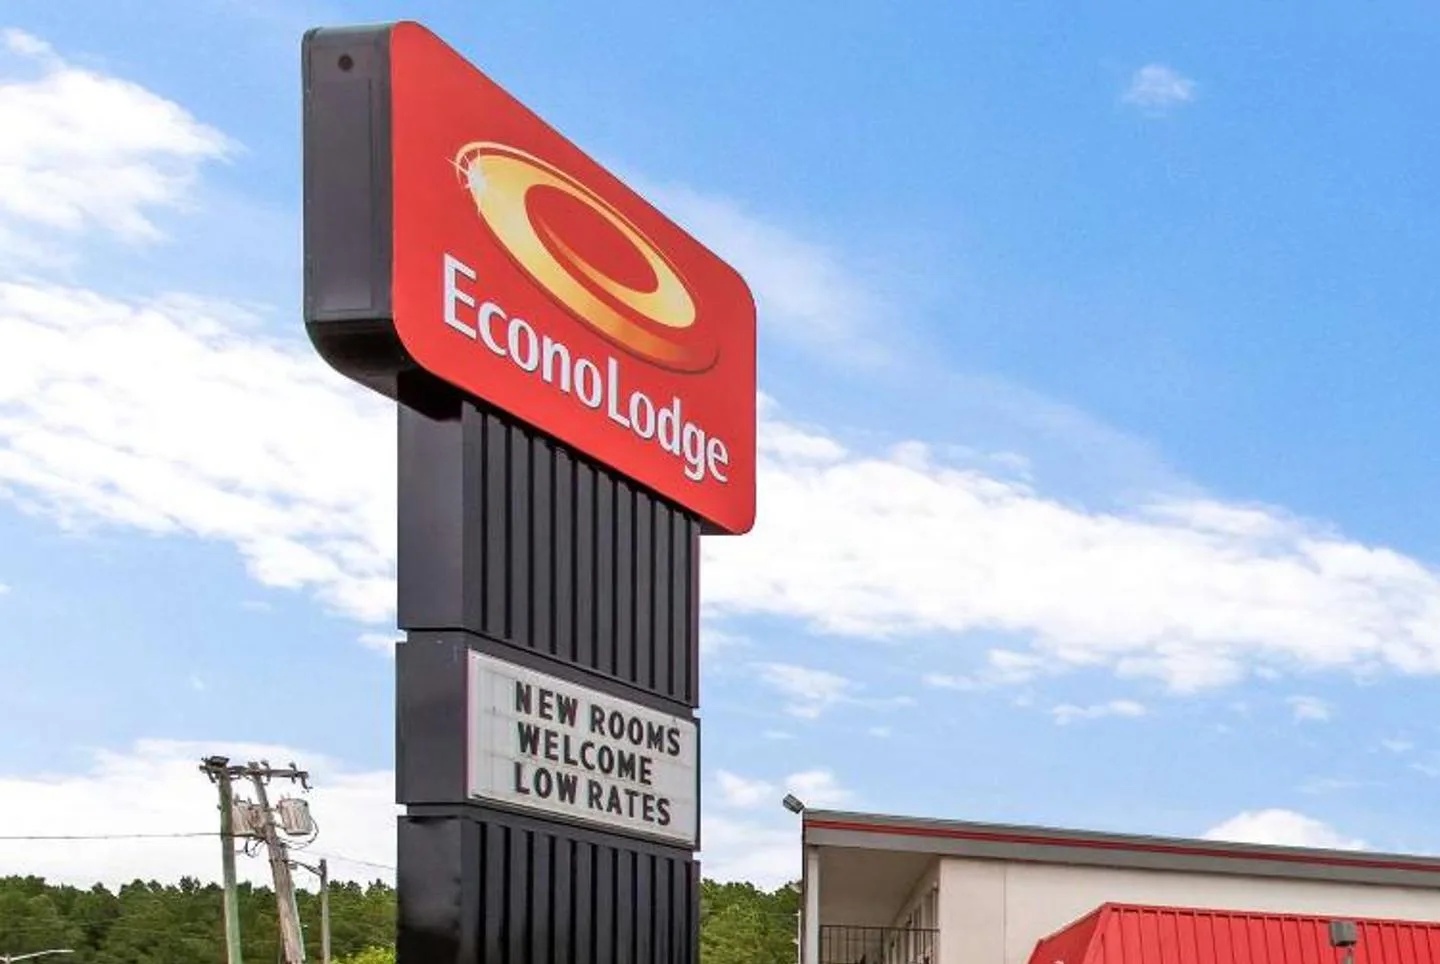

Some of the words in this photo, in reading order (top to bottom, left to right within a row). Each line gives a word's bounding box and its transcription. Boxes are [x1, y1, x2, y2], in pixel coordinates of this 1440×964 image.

[442, 252, 730, 484] EconoLodge
[515, 680, 579, 728] NEW
[590, 703, 681, 756] ROOMS
[518, 721, 653, 786] WELCOME
[514, 762, 579, 805] LOW
[588, 779, 672, 826] RATES
